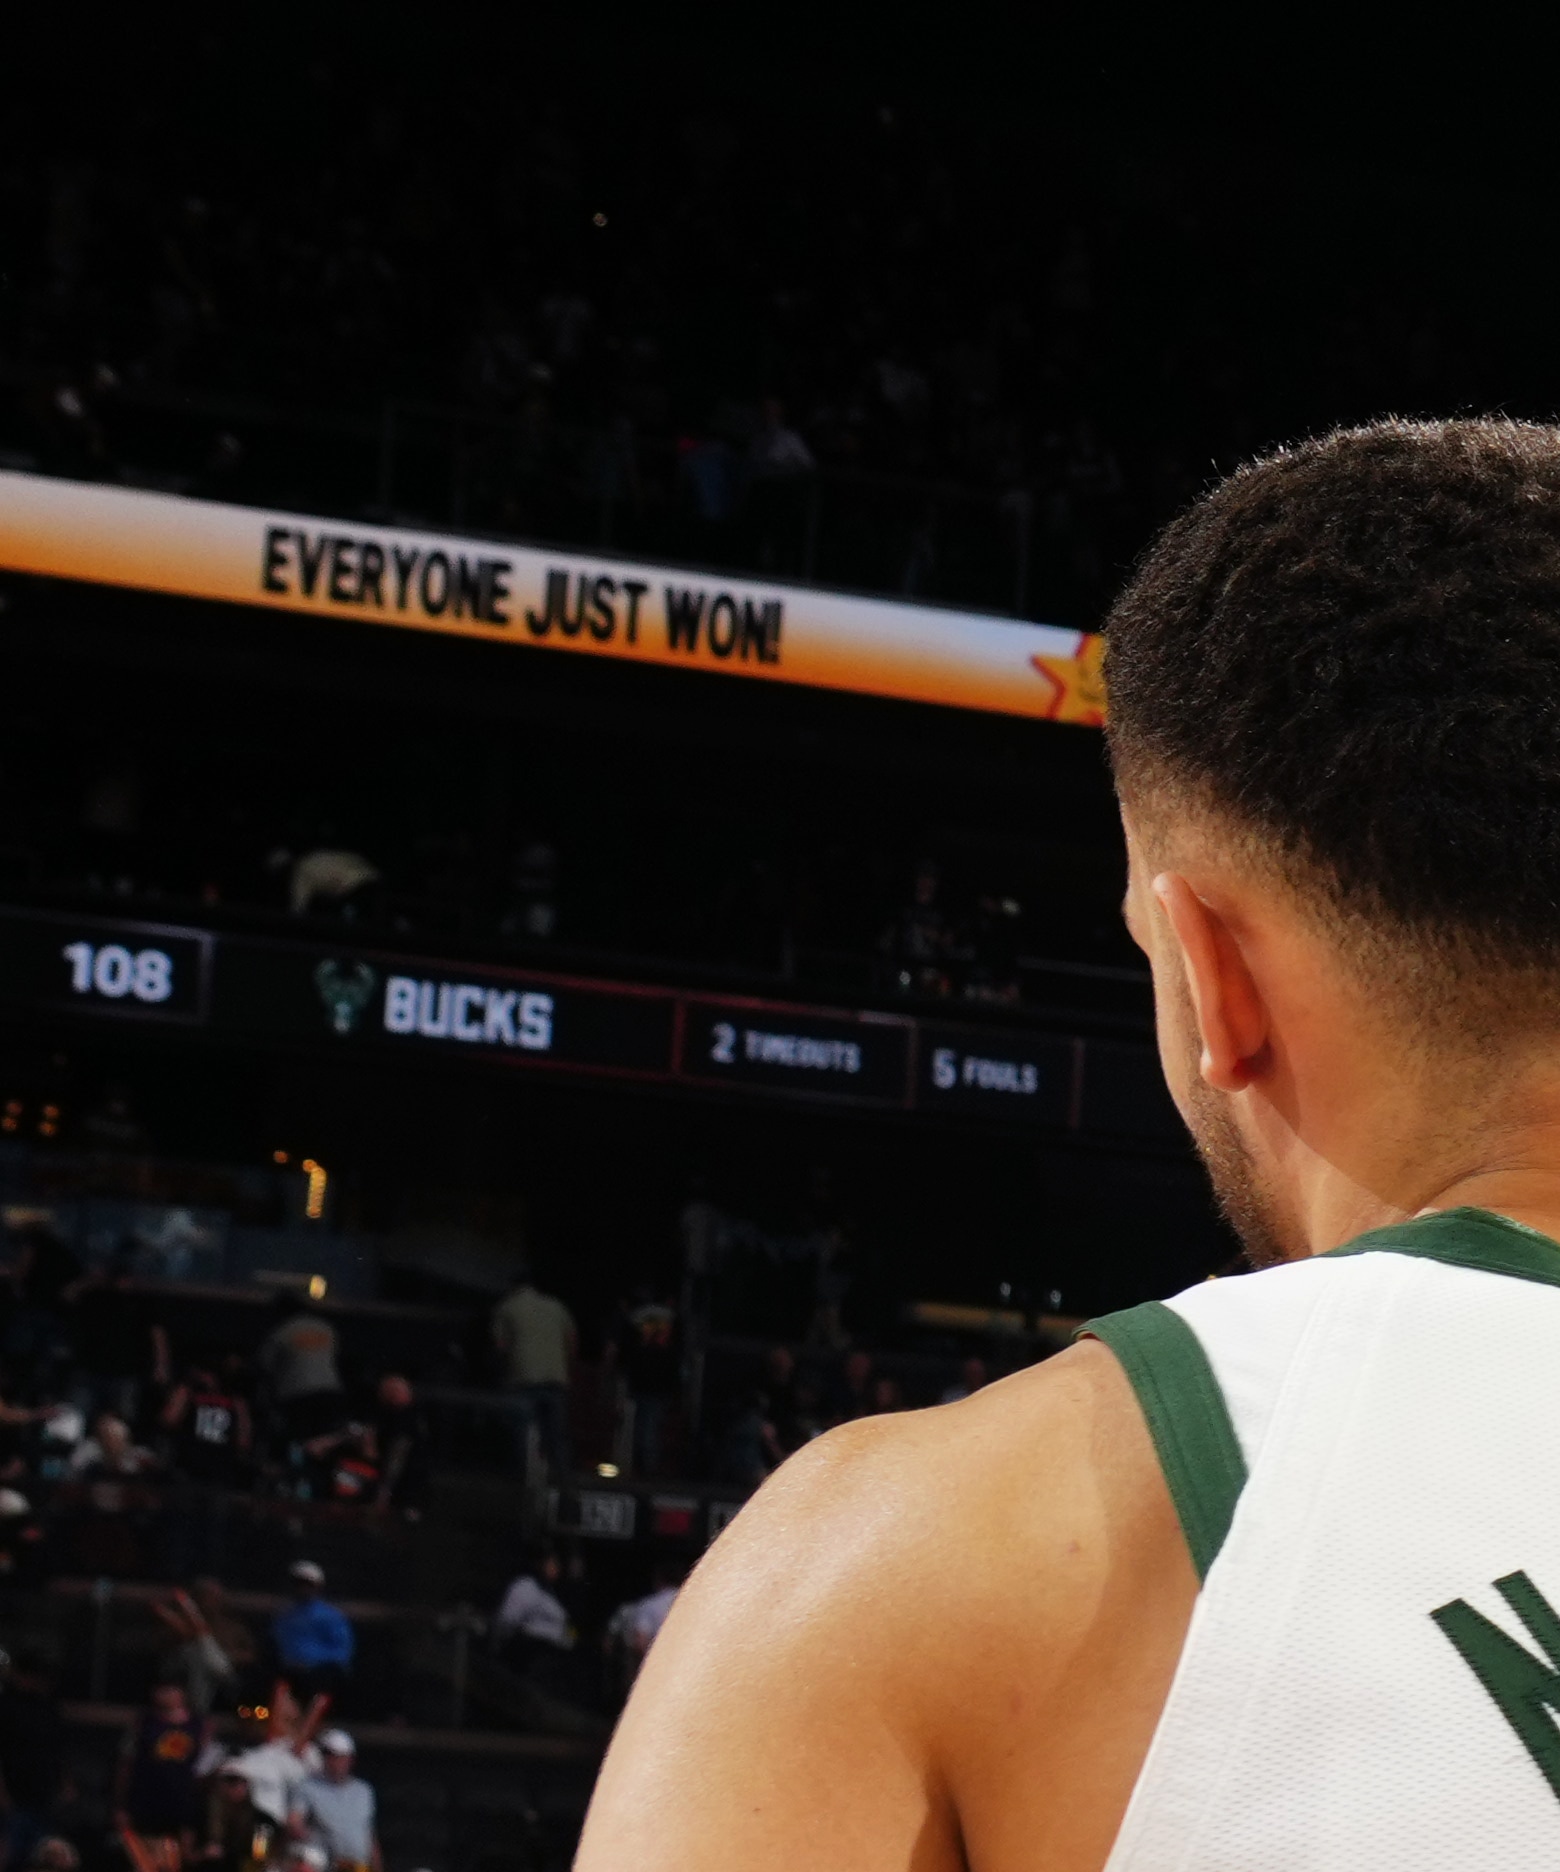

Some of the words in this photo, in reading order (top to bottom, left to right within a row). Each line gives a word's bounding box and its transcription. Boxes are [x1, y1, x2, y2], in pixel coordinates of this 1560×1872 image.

[262, 525, 512, 626] EVERYONE
[525, 569, 648, 645] JUST
[663, 584, 784, 665] WON!
[63, 942, 173, 1002] 108
[384, 976, 554, 1050] BUCKS
[708, 1021, 736, 1064] 2
